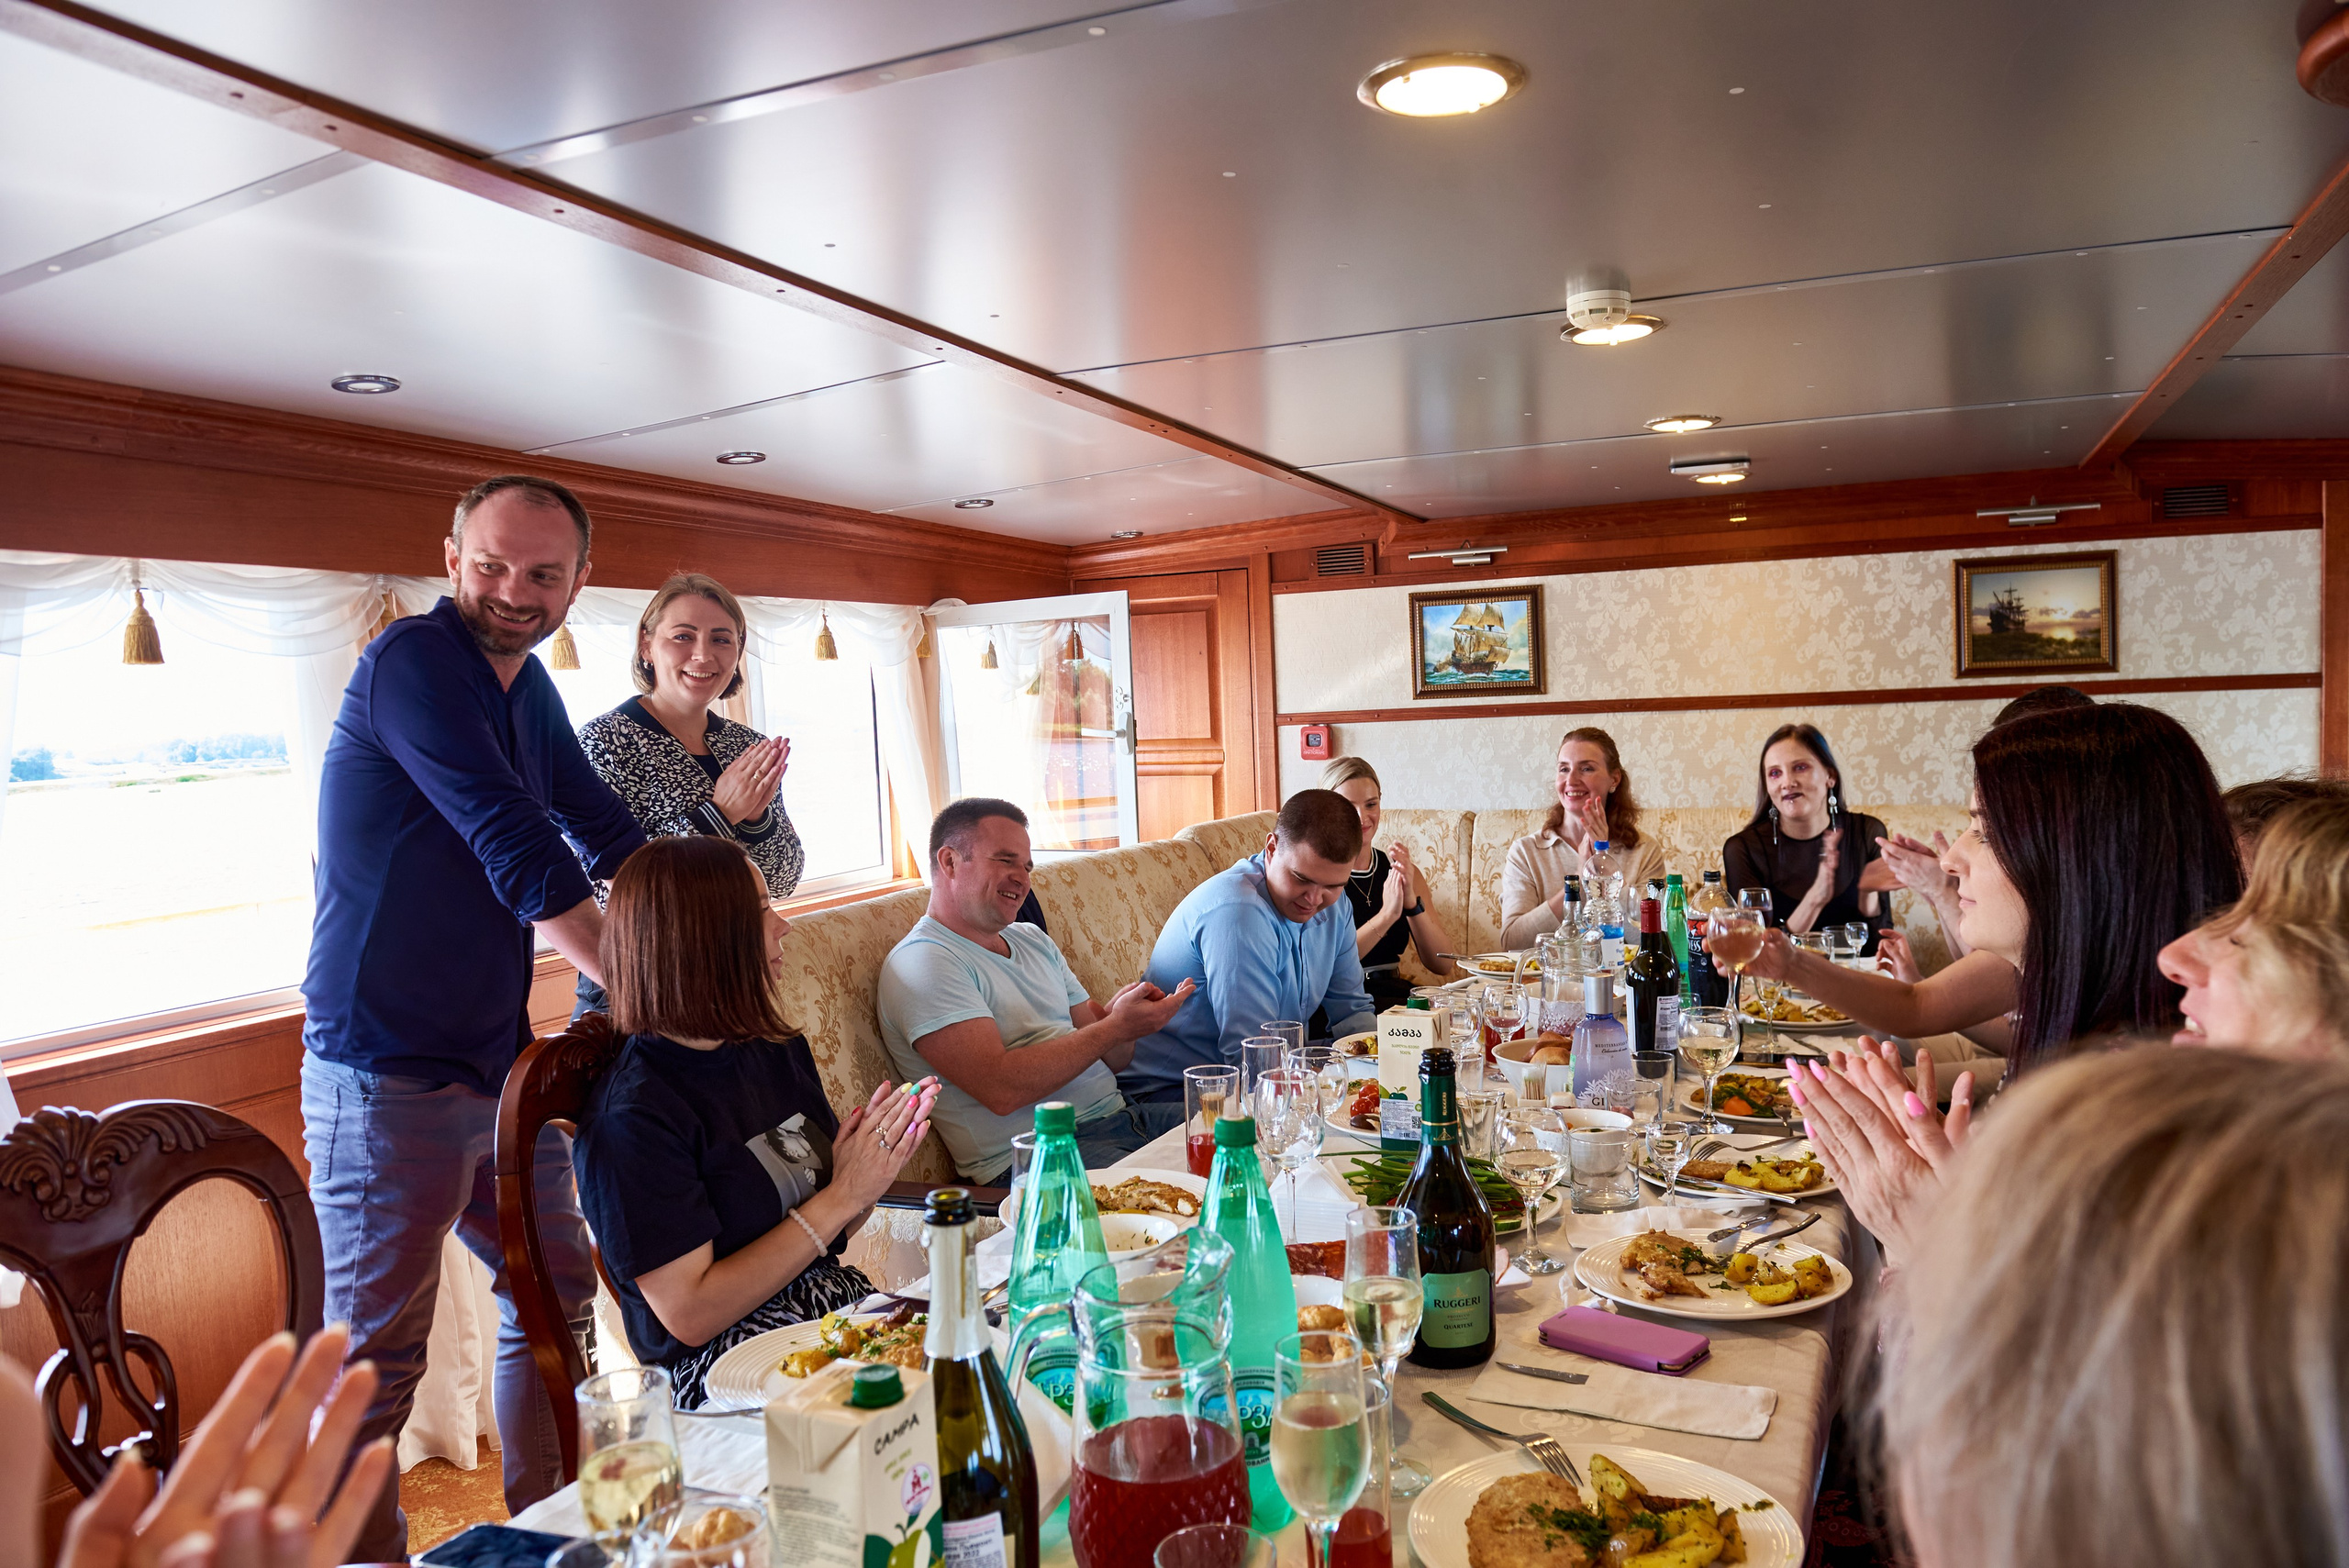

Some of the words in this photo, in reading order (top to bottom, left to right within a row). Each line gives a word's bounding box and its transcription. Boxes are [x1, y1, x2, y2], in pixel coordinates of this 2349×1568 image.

[1433, 1296, 1481, 1308] RUGGERI
[1443, 1322, 1473, 1330] QUARTESE
[874, 1413, 919, 1456] CAMPA
